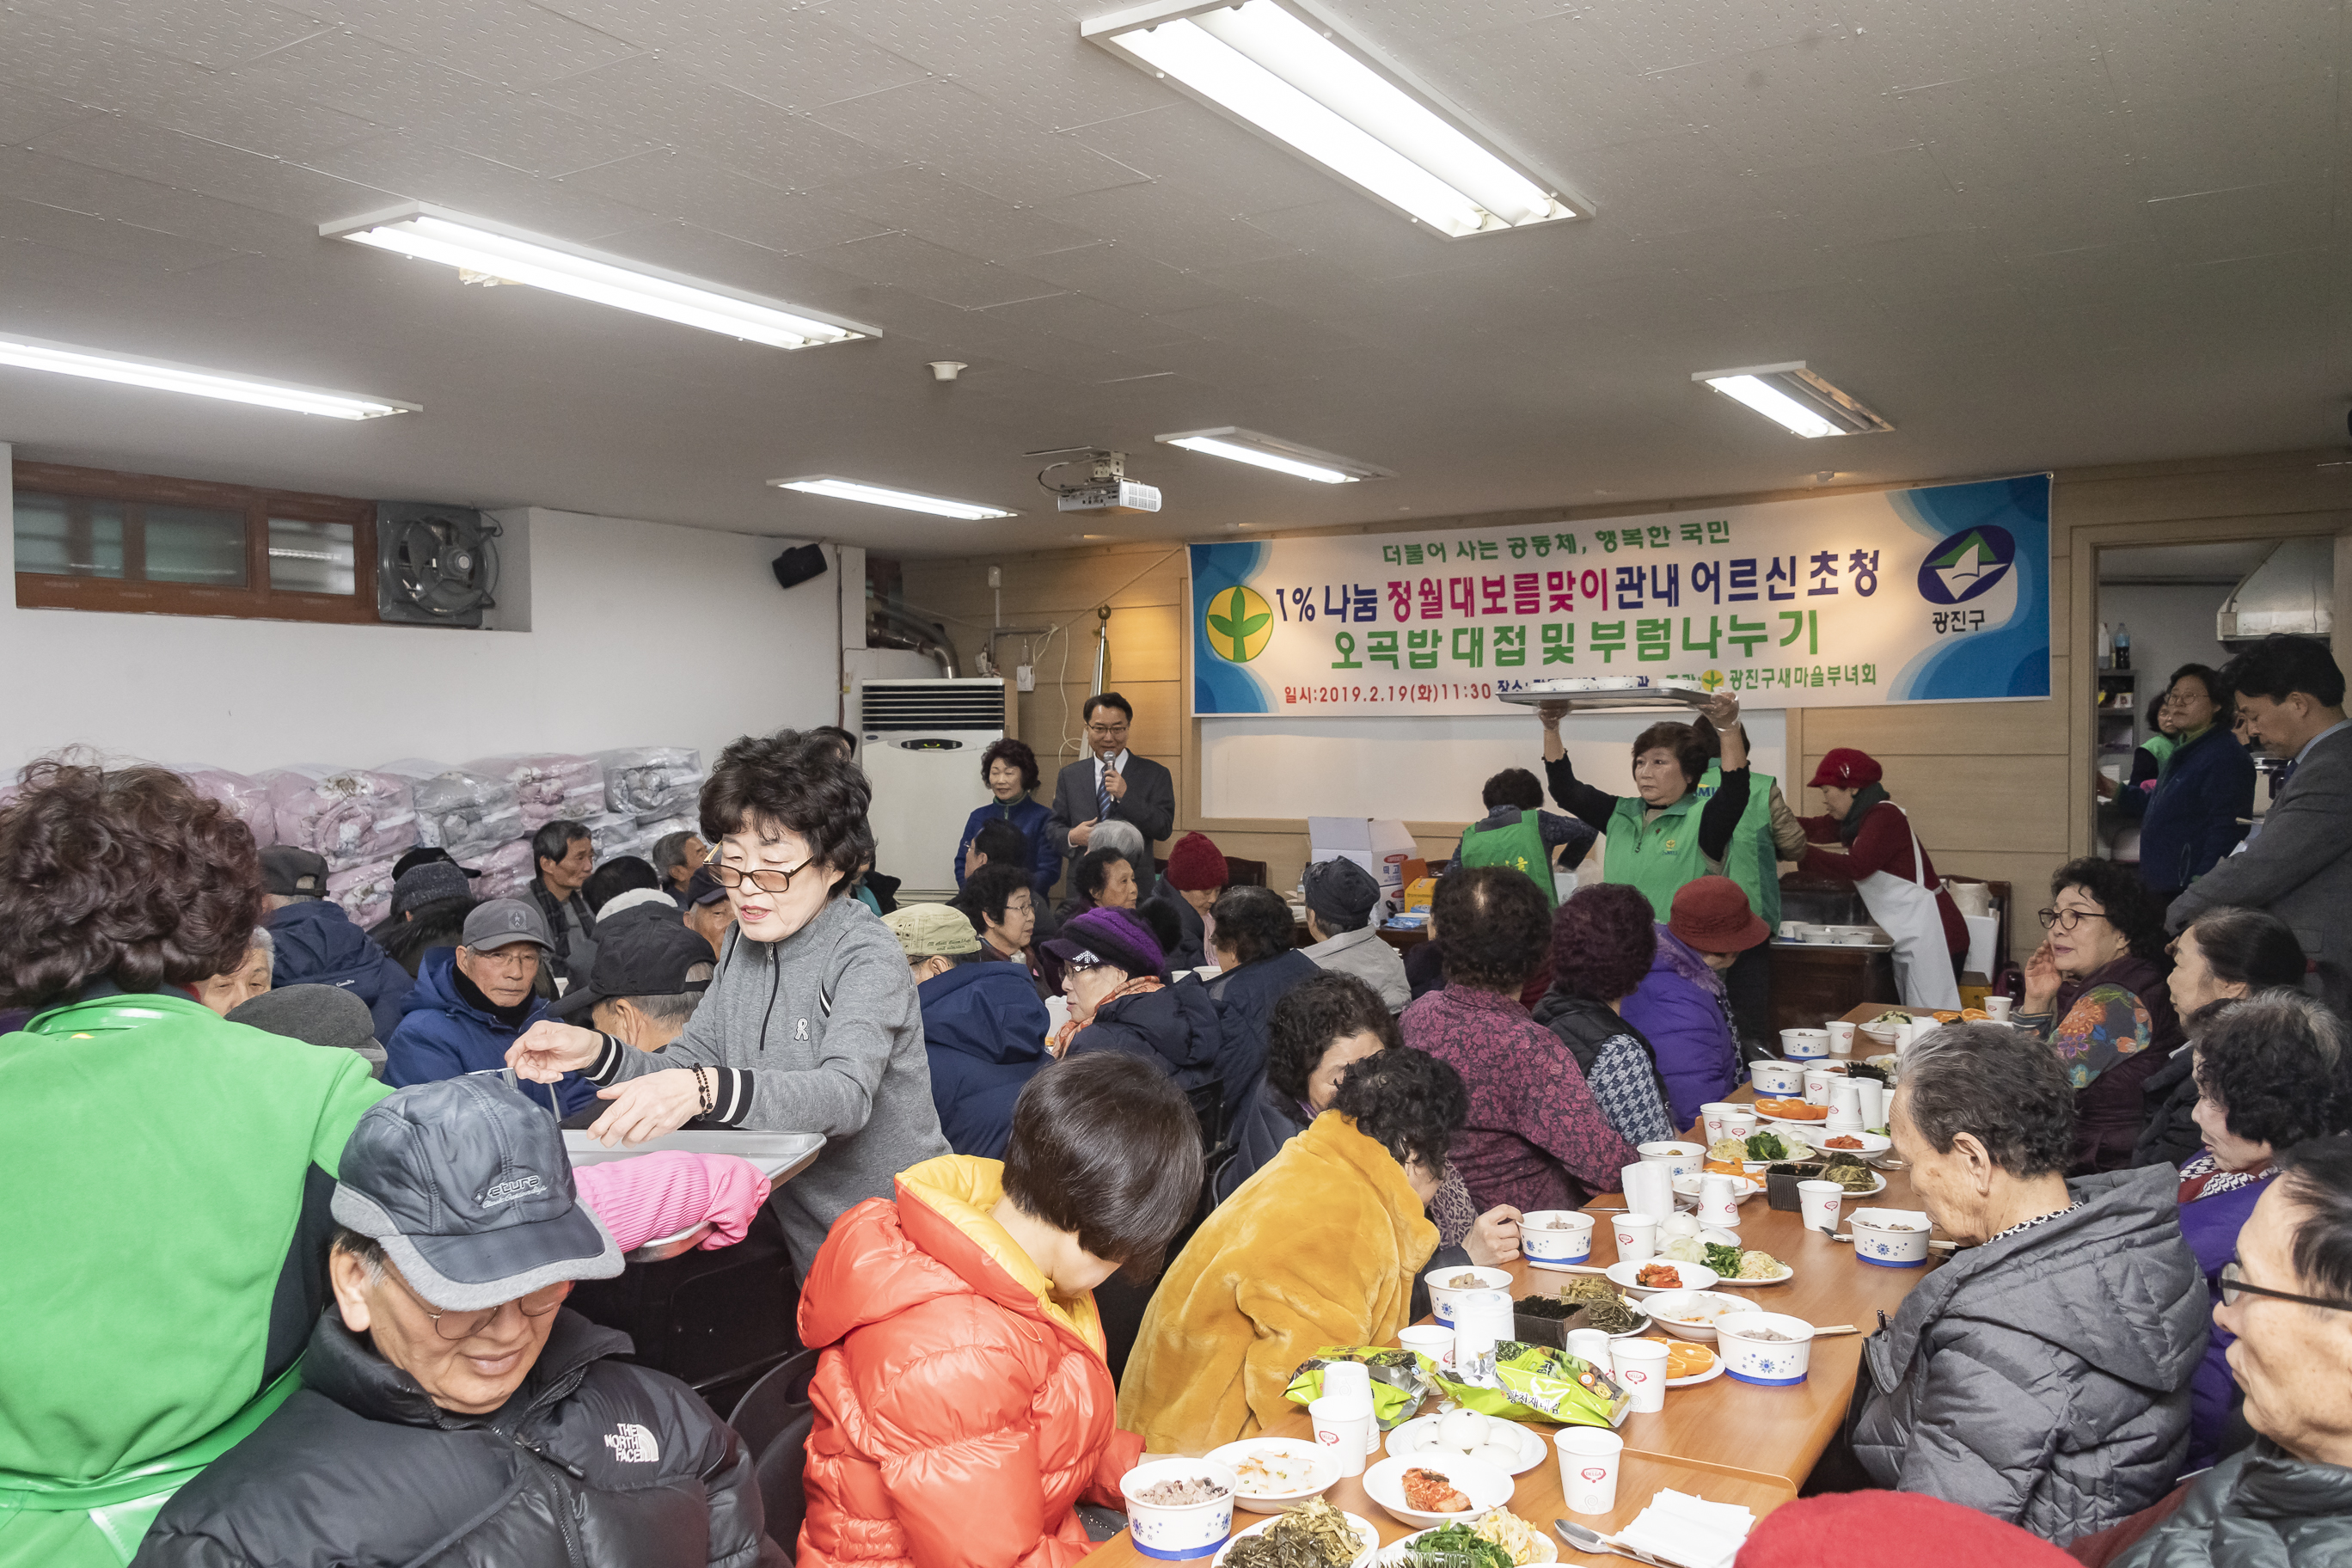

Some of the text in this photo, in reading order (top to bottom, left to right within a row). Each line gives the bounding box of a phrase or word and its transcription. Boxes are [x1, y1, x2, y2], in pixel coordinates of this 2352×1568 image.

[1382, 520, 1730, 566] 더불어 사는 공동체, 행복한 국민
[1276, 587, 1316, 623] 1%
[1324, 583, 1378, 622] 나눔
[1932, 609, 1986, 634] 광진구
[1331, 628, 1443, 671] 오곡밥
[1729, 663, 1877, 692] 광진구새마을부녀회
[604, 1434, 640, 1449] NORTH
[617, 1423, 638, 1436] THE
[616, 1449, 641, 1463] FACE
